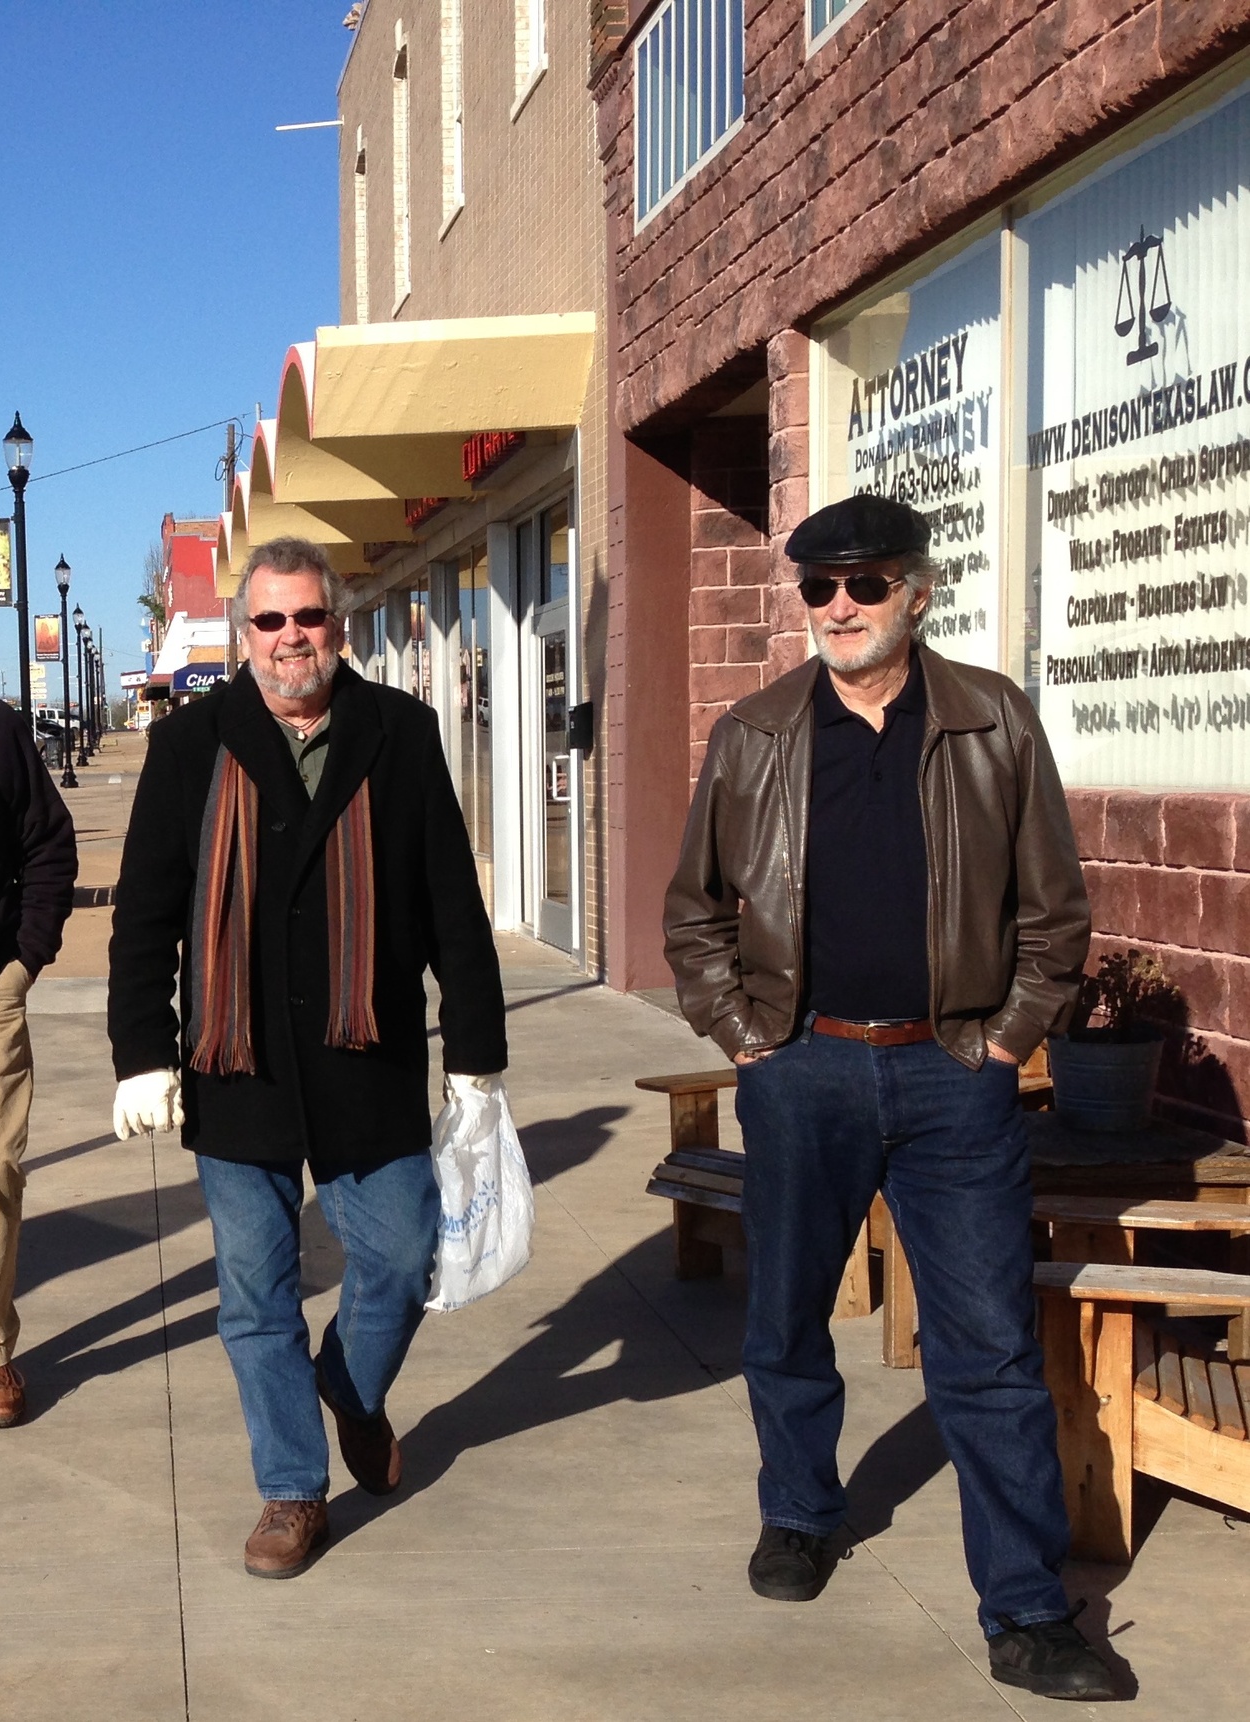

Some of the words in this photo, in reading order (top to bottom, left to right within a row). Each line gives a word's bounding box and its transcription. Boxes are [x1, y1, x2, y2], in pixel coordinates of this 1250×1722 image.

[848, 332, 968, 441] ATTORNEY
[855, 439, 893, 473] DONALD
[890, 451, 960, 503] 463-0008
[1048, 484, 1089, 522] DIVORCE
[1100, 468, 1149, 509] CUSTODY
[1160, 454, 1197, 493] CHILD
[1069, 539, 1102, 571] WILLS
[1113, 524, 1163, 563] PROBATE
[1174, 508, 1228, 551] ESTATES
[1067, 590, 1127, 628] CORPORATE
[1138, 580, 1197, 618] BUSINESS
[1200, 573, 1229, 609] LAW
[1047, 654, 1098, 686] PERSONAL
[1102, 648, 1140, 681] INJURY
[1150, 643, 1181, 677] AUTO
